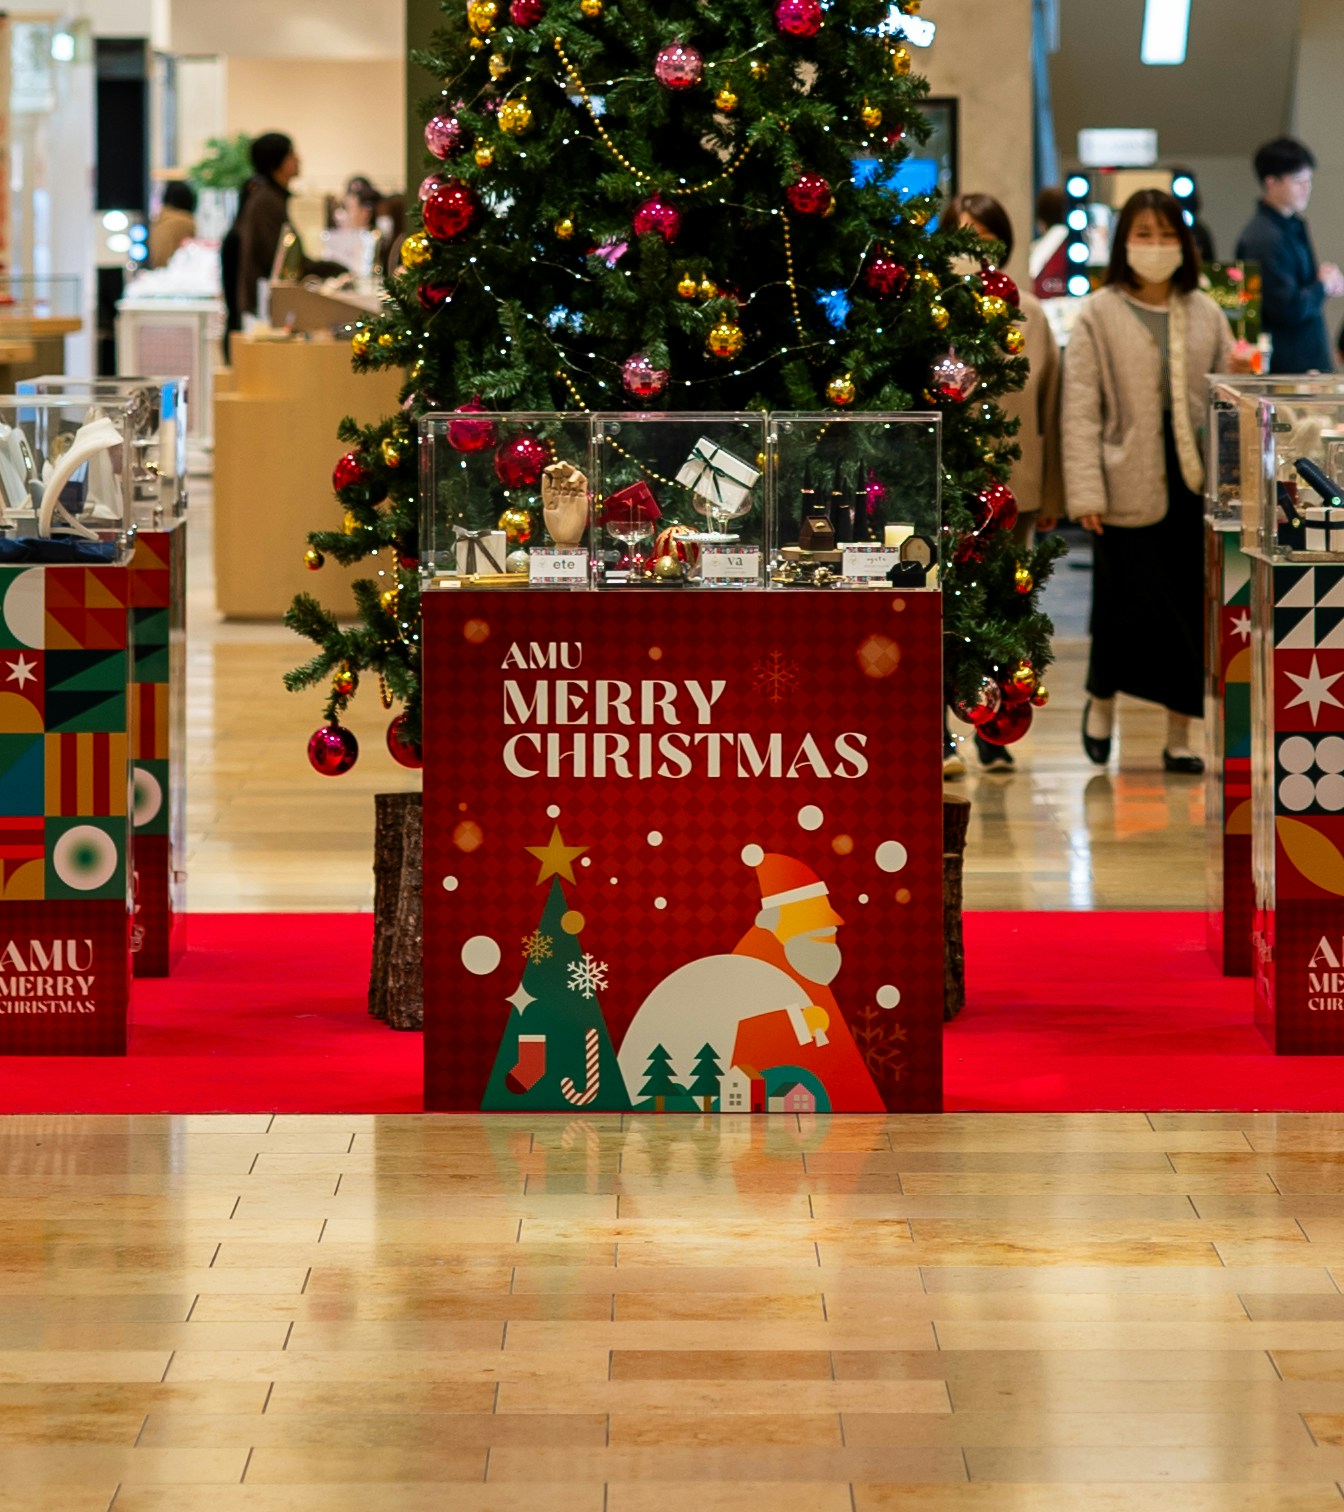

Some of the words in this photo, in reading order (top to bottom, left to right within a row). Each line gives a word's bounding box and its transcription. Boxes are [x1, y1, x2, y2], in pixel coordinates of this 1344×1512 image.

[552, 559, 576, 570] ete
[501, 641, 583, 669] AMU
[503, 679, 726, 725] MERRY
[502, 732, 868, 780] CHRISTMAS
